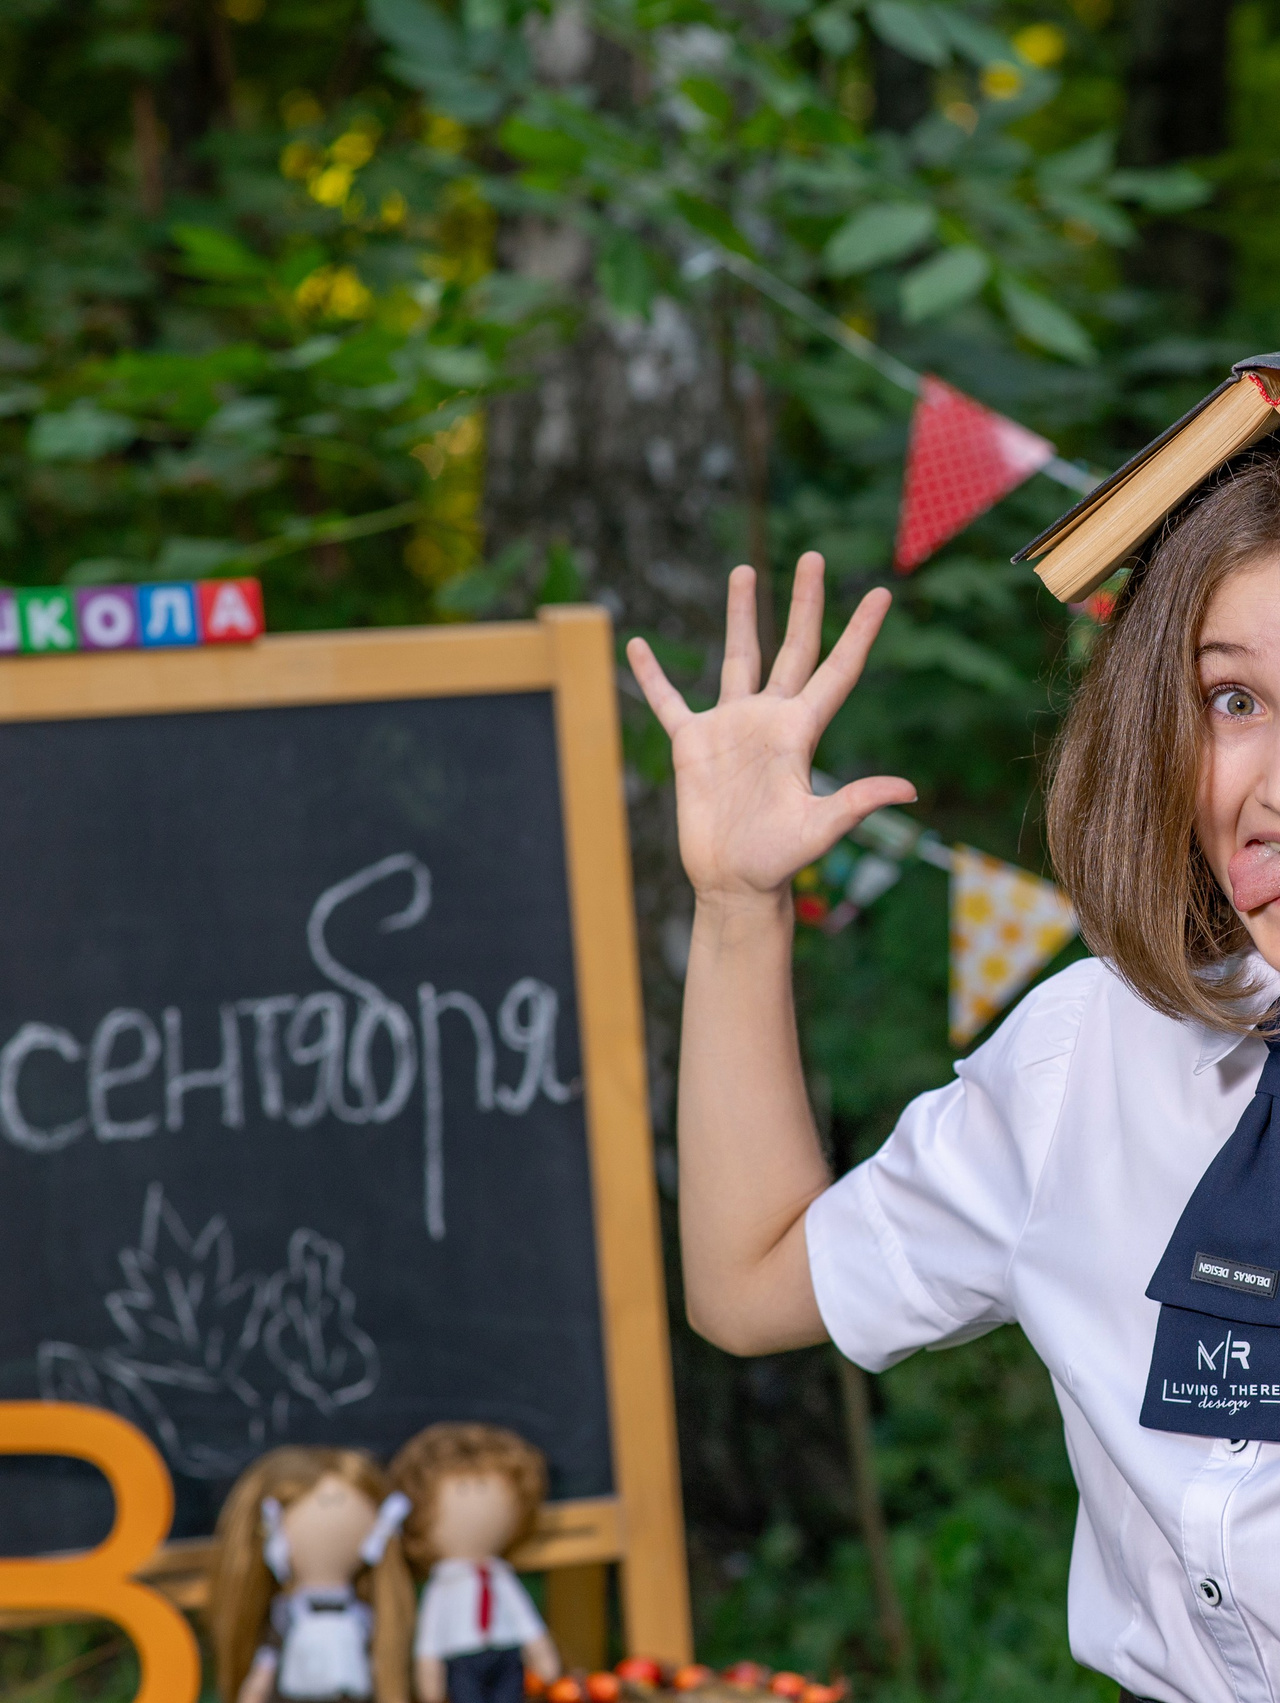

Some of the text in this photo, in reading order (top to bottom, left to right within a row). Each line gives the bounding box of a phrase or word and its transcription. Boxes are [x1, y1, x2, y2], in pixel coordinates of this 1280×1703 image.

[1199, 1262, 1271, 1288] DELORAS DESIGN
[1172, 1383, 1280, 1396] LIVING THERE
[1198, 1397, 1250, 1416] design
